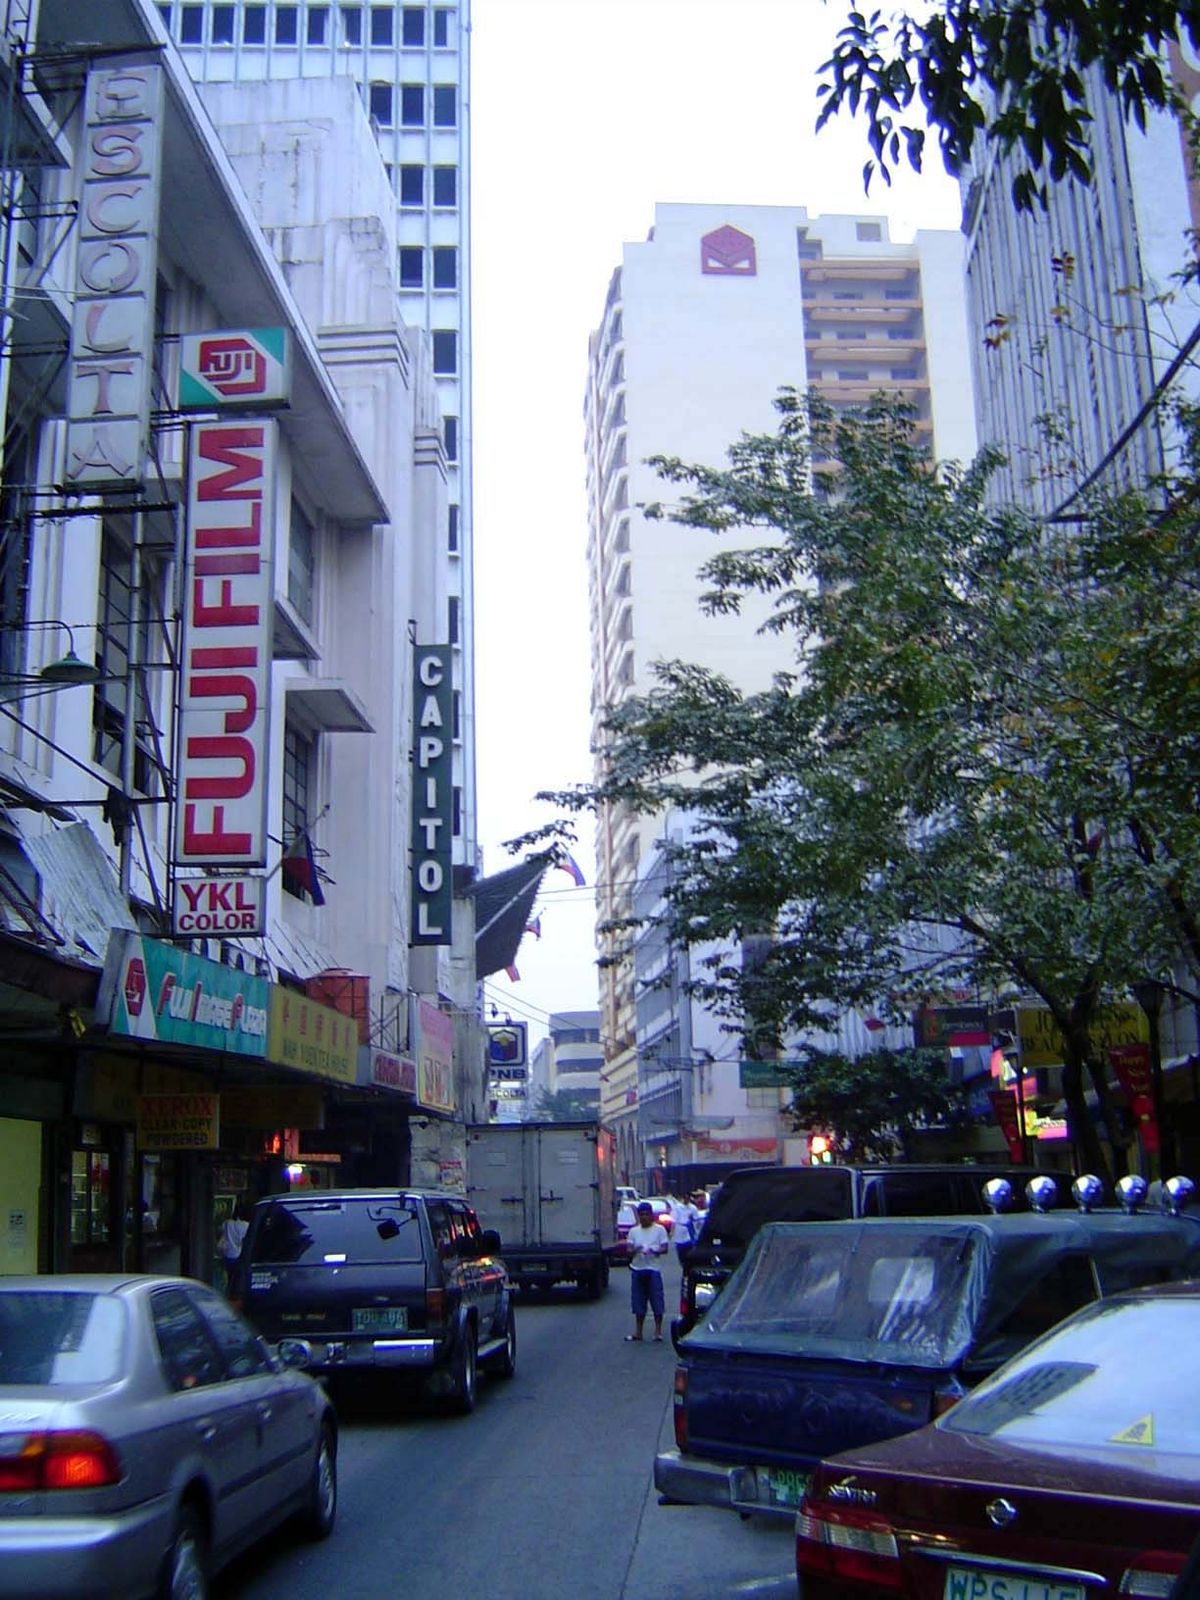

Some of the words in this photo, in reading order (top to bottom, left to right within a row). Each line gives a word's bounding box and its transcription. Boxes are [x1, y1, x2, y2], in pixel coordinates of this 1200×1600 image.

[66, 76, 147, 480] ESCOLTA
[418, 655, 444, 936] CAPITOL
[178, 912, 255, 931] COLOR
[180, 881, 256, 912] YKL
